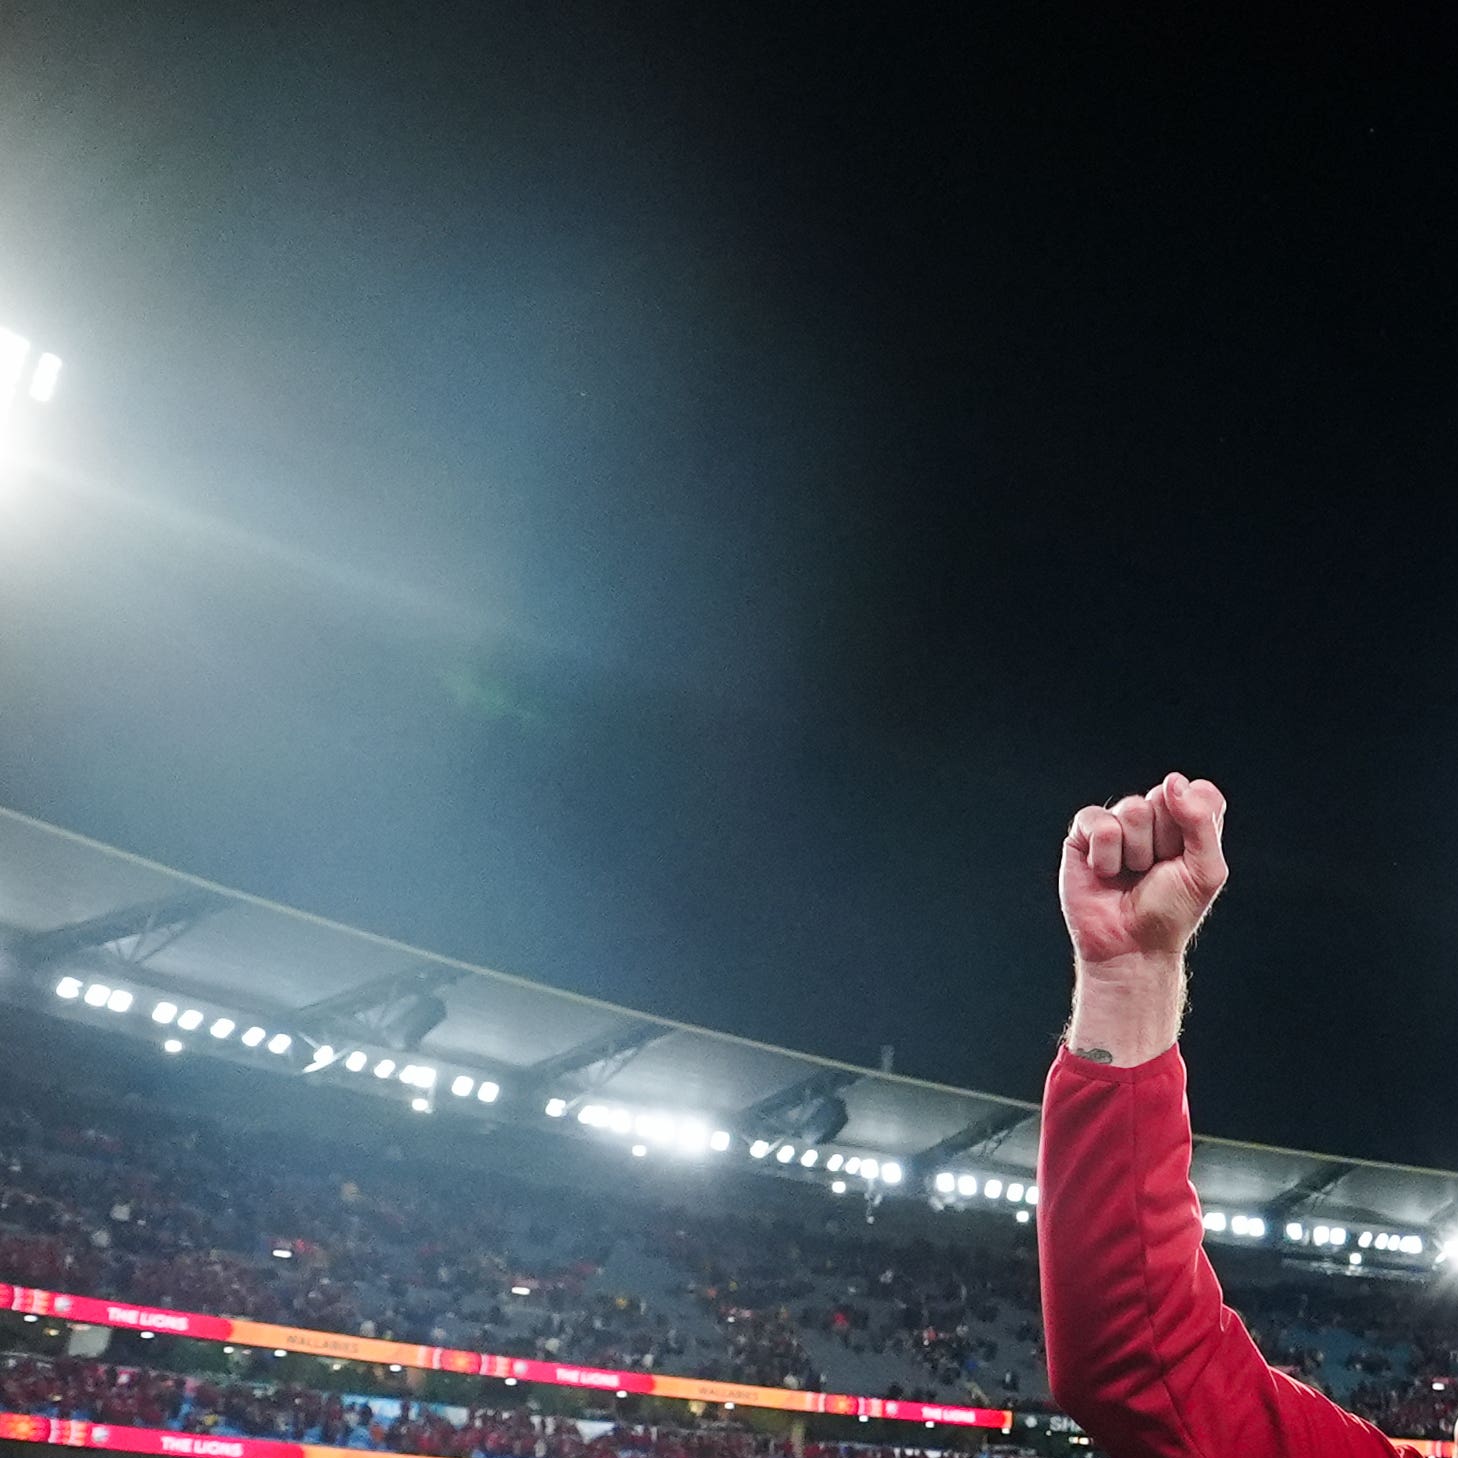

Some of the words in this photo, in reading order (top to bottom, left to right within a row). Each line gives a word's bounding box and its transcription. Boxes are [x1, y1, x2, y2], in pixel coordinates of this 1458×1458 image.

[107, 1306, 138, 1324] THE
[139, 1310, 190, 1332] LIONS
[161, 1436, 192, 1453] THE
